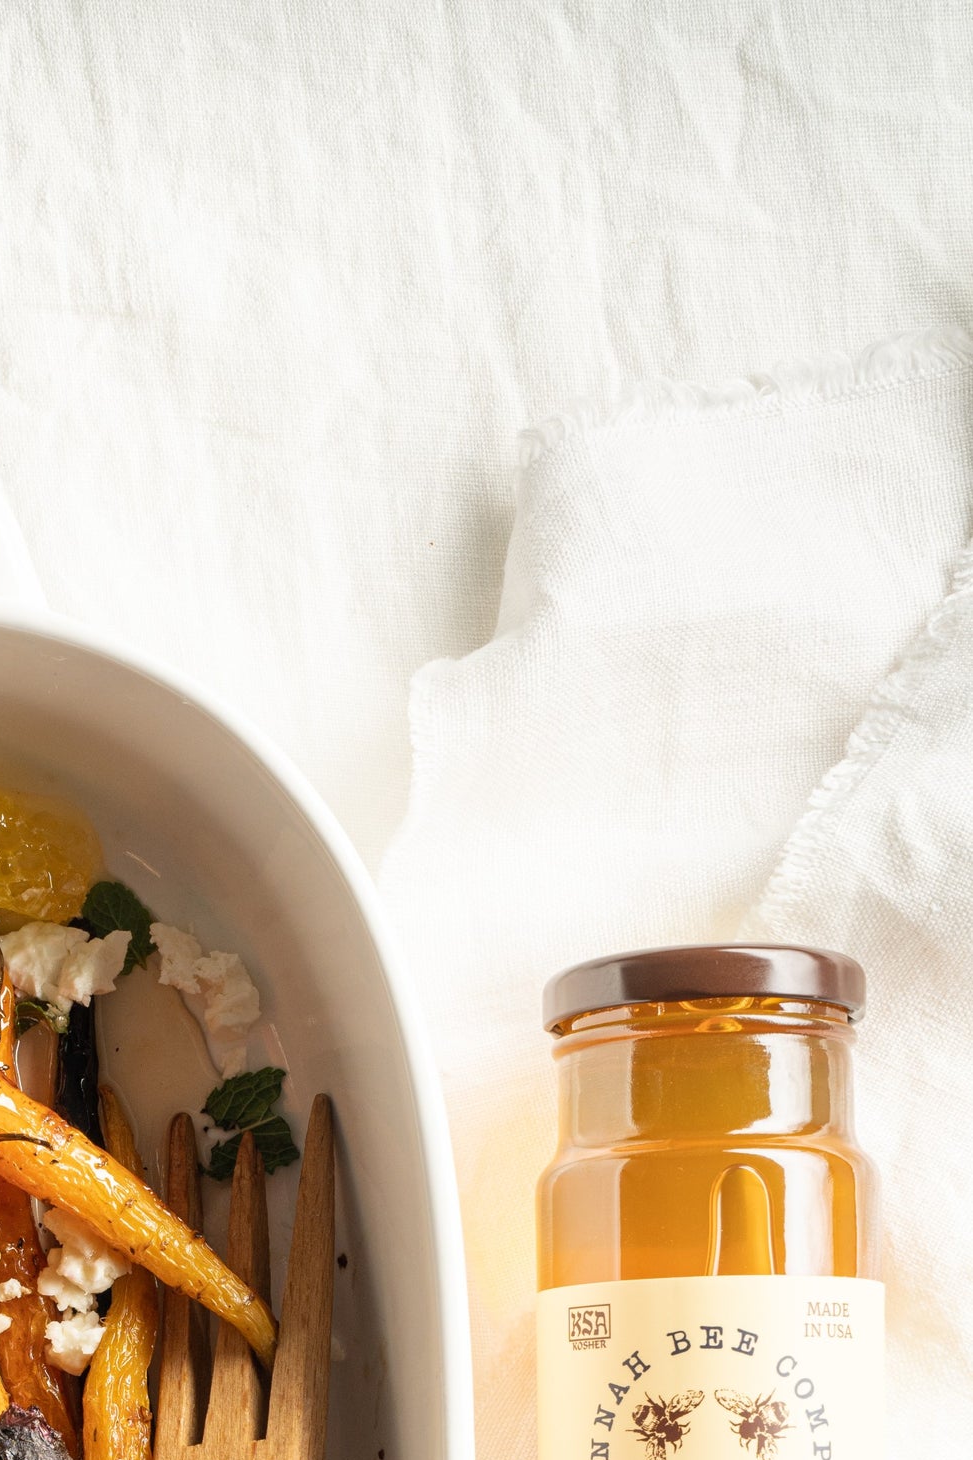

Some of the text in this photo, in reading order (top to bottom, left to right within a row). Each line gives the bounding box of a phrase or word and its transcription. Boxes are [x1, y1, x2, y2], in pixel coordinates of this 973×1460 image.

[806, 1301, 850, 1318] MADE
[569, 1310, 608, 1338] KSA
[803, 1322, 854, 1340] IN USA
[571, 1339, 608, 1351] KOSHER
[666, 1325, 759, 1357] BEE
